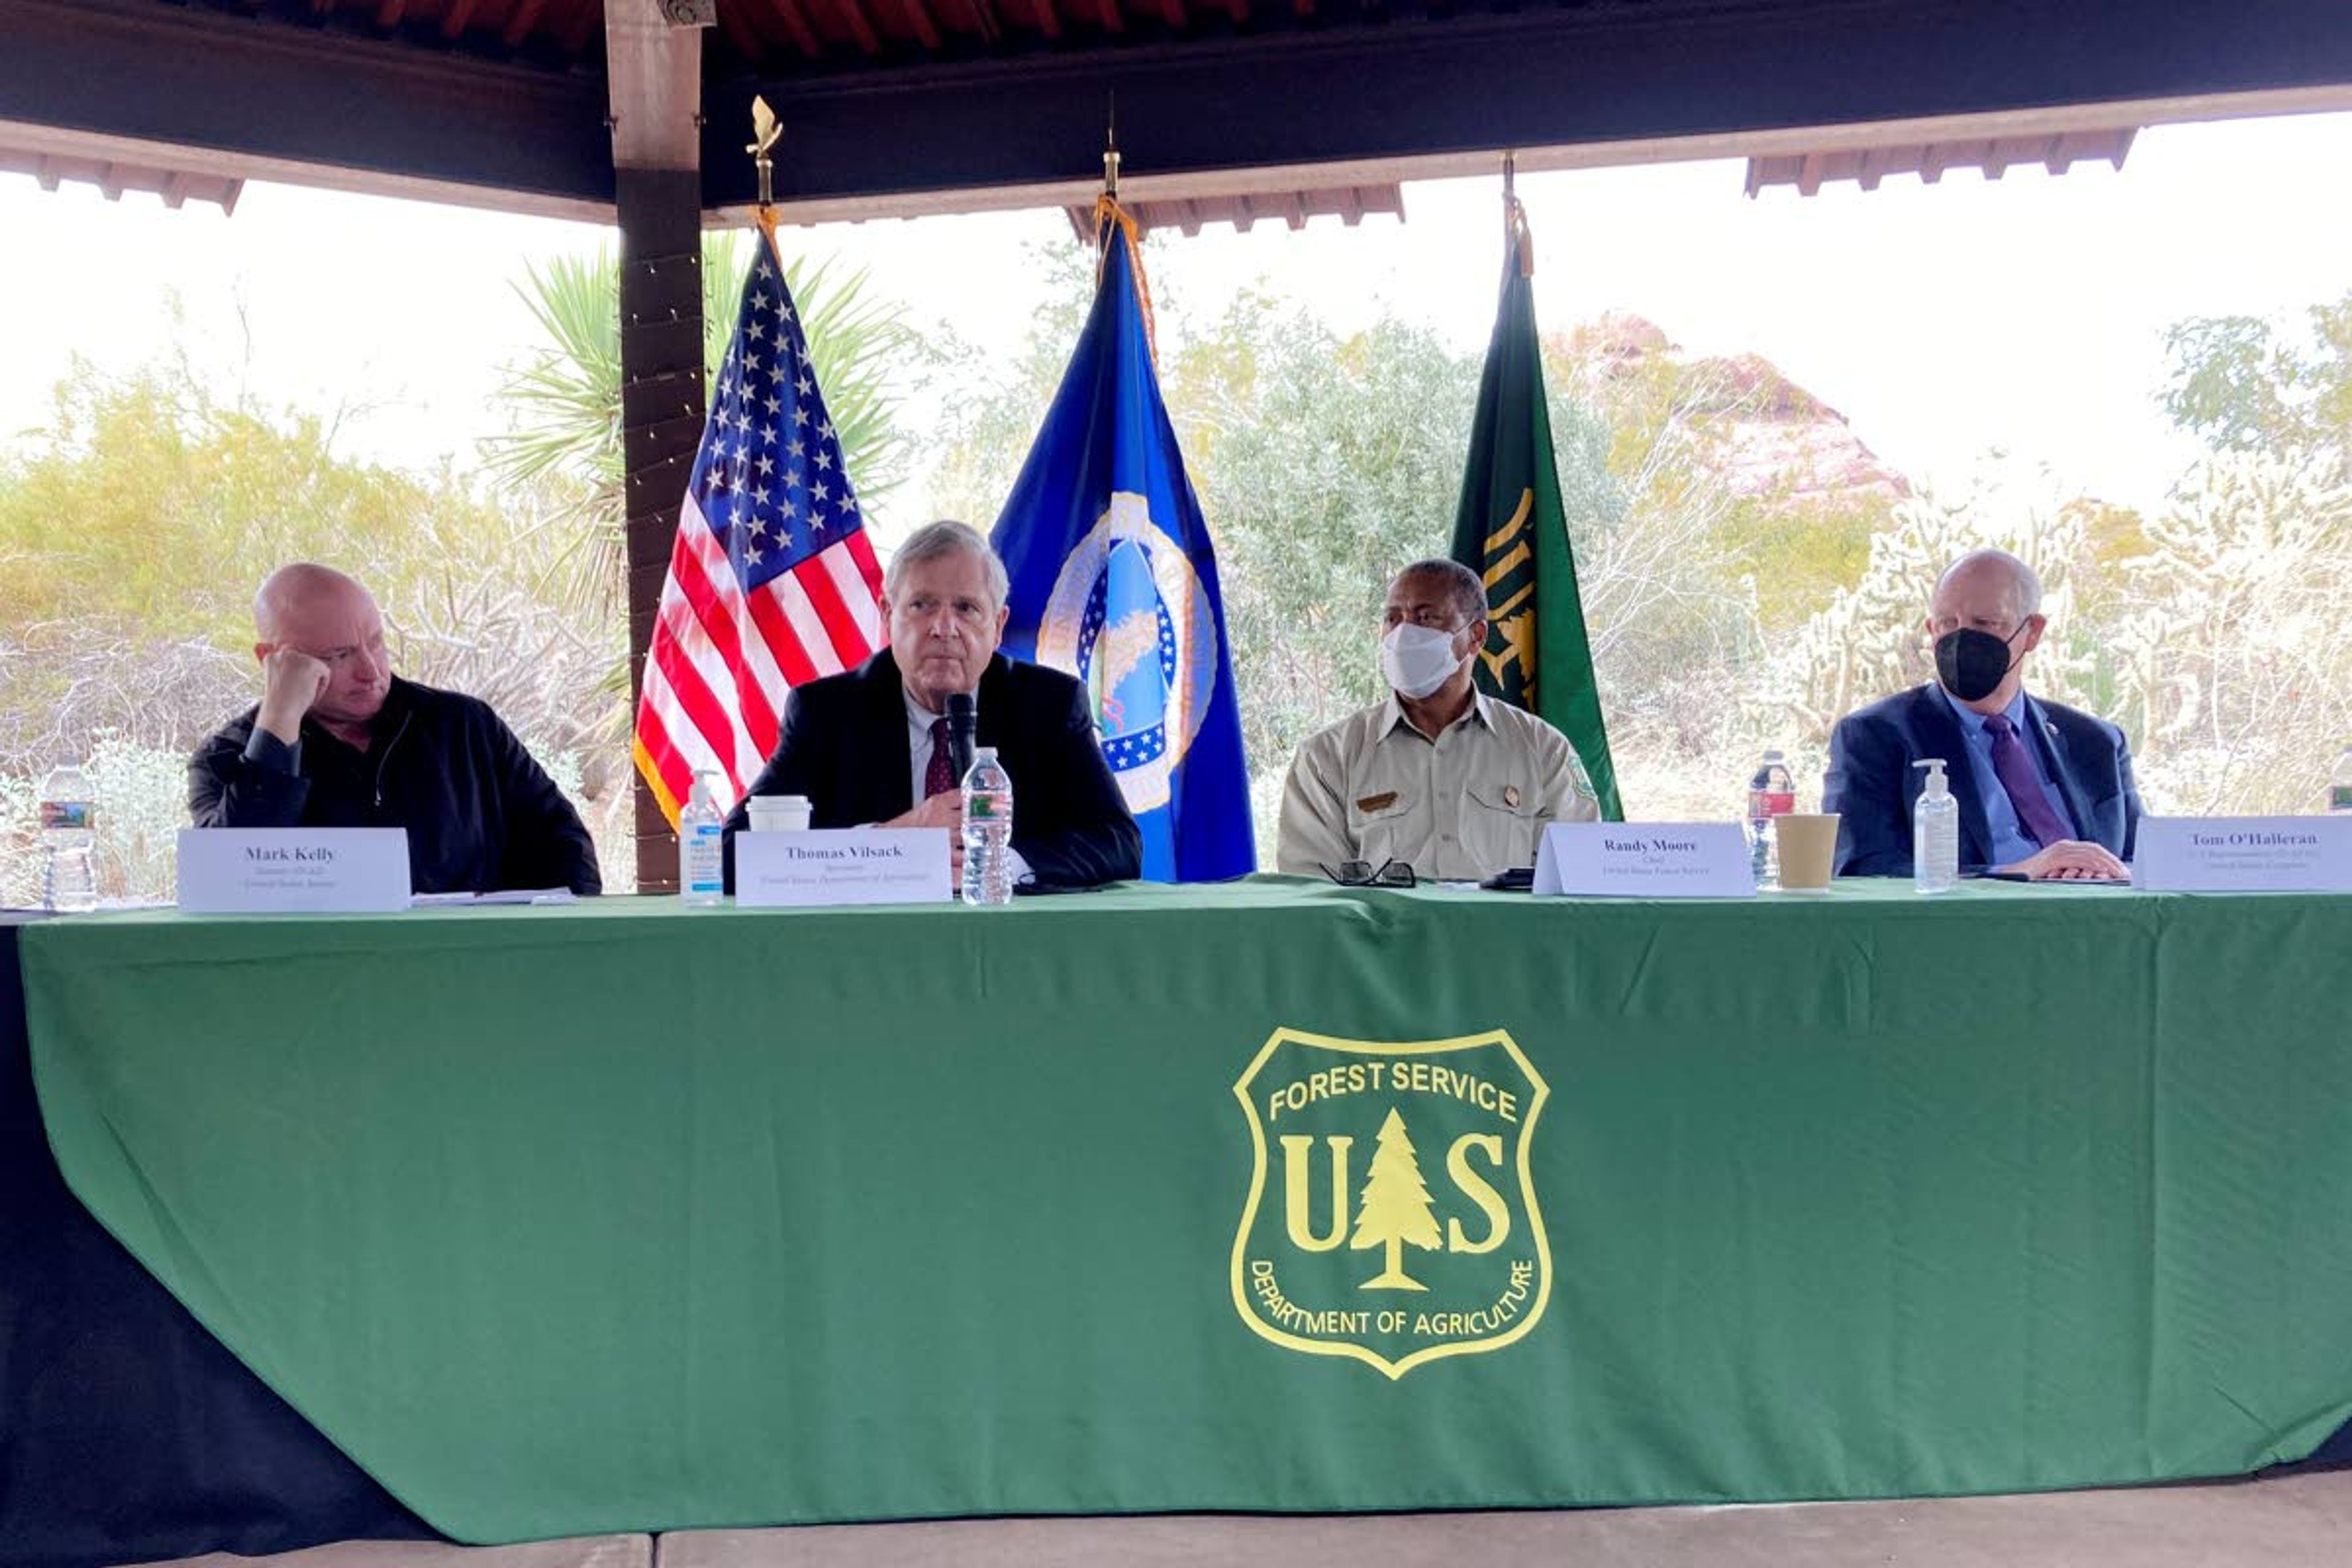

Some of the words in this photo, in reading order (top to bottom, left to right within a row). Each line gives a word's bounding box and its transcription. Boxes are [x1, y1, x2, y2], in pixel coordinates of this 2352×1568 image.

[1605, 839, 1648, 854] Randy
[1653, 839, 1696, 851] Moore
[2193, 832, 2225, 846] Tom
[2229, 831, 2319, 846] O'Halleran
[247, 846, 288, 861] Mark
[296, 846, 333, 864] Kelly
[786, 846, 846, 861] Thomas
[850, 844, 903, 858] Vilsack
[1268, 1061, 1385, 1121] FOREST
[1391, 1061, 1518, 1123] SERVICE
[1251, 1260, 1371, 1334] DEPARTMENT
[1376, 1311, 1407, 1333] OF
[1413, 1260, 1532, 1335] AGRICULTURE
